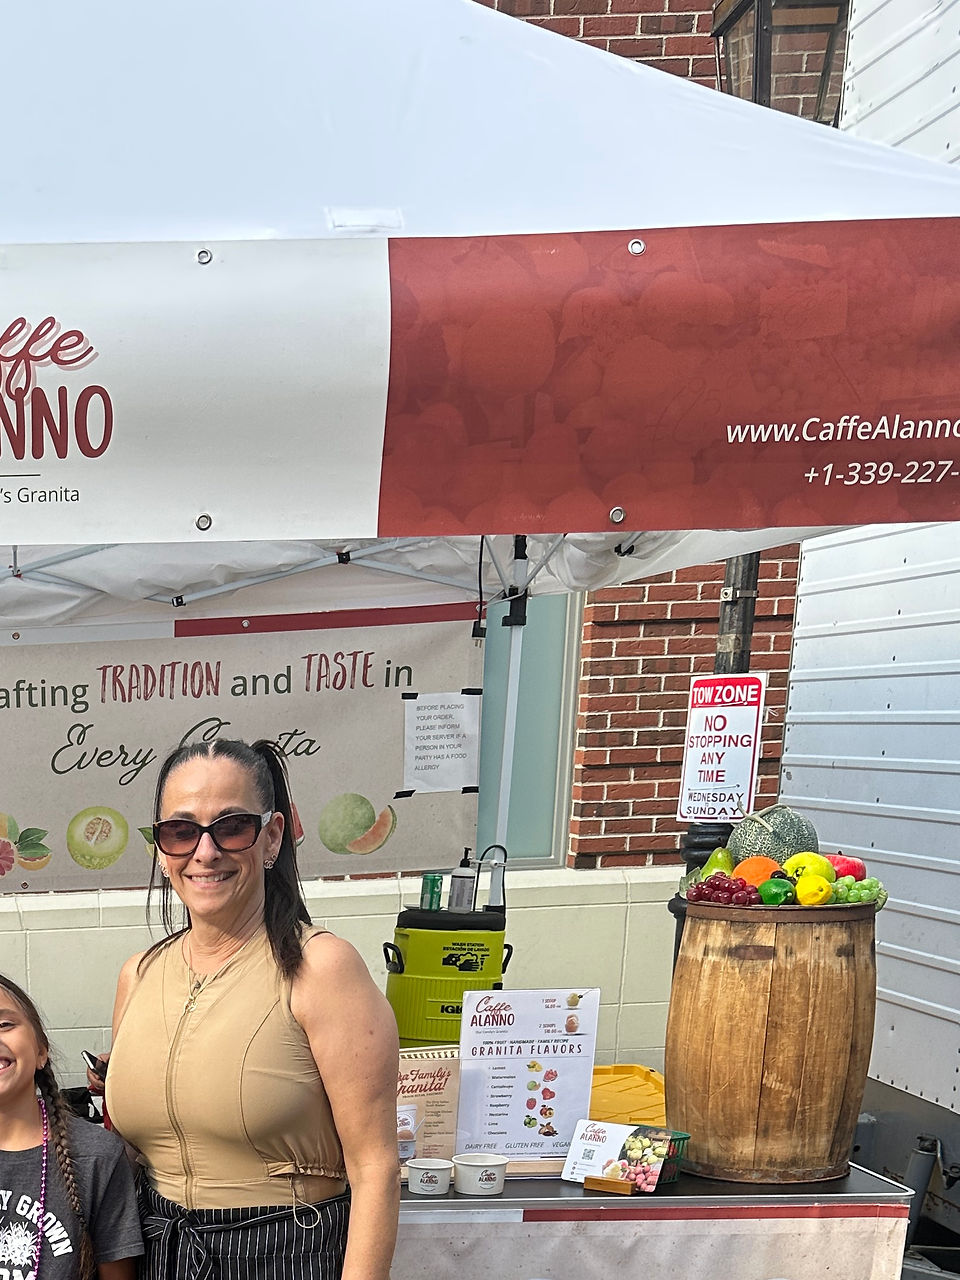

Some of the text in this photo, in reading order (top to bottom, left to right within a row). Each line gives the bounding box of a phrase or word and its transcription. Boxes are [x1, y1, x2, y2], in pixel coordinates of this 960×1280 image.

[803, 460, 959, 486] +1-339-227-
[17, 486, 80, 503] Granita
[96, 660, 222, 704] TRADITION
[231, 665, 292, 696] and
[301, 650, 376, 693] TASTE
[384, 659, 414, 688] in
[692, 684, 759, 704] TOW ZONE
[704, 714, 727, 732] NO
[689, 734, 752, 749] STOPPING
[51, 723, 157, 786] Every
[700, 752, 725, 765] ANY
[698, 770, 725, 783] TIME
[688, 792, 744, 803] WEDNESDAY
[686, 806, 739, 815] SUNDAY
[475, 995, 513, 1016] Caffe
[470, 1013, 515, 1027] ALANNO
[471, 1043, 582, 1056] GRANITA FLAVORS
[580, 1132, 607, 1143] ALANNO
[15, 1194, 74, 1258] GROWN
